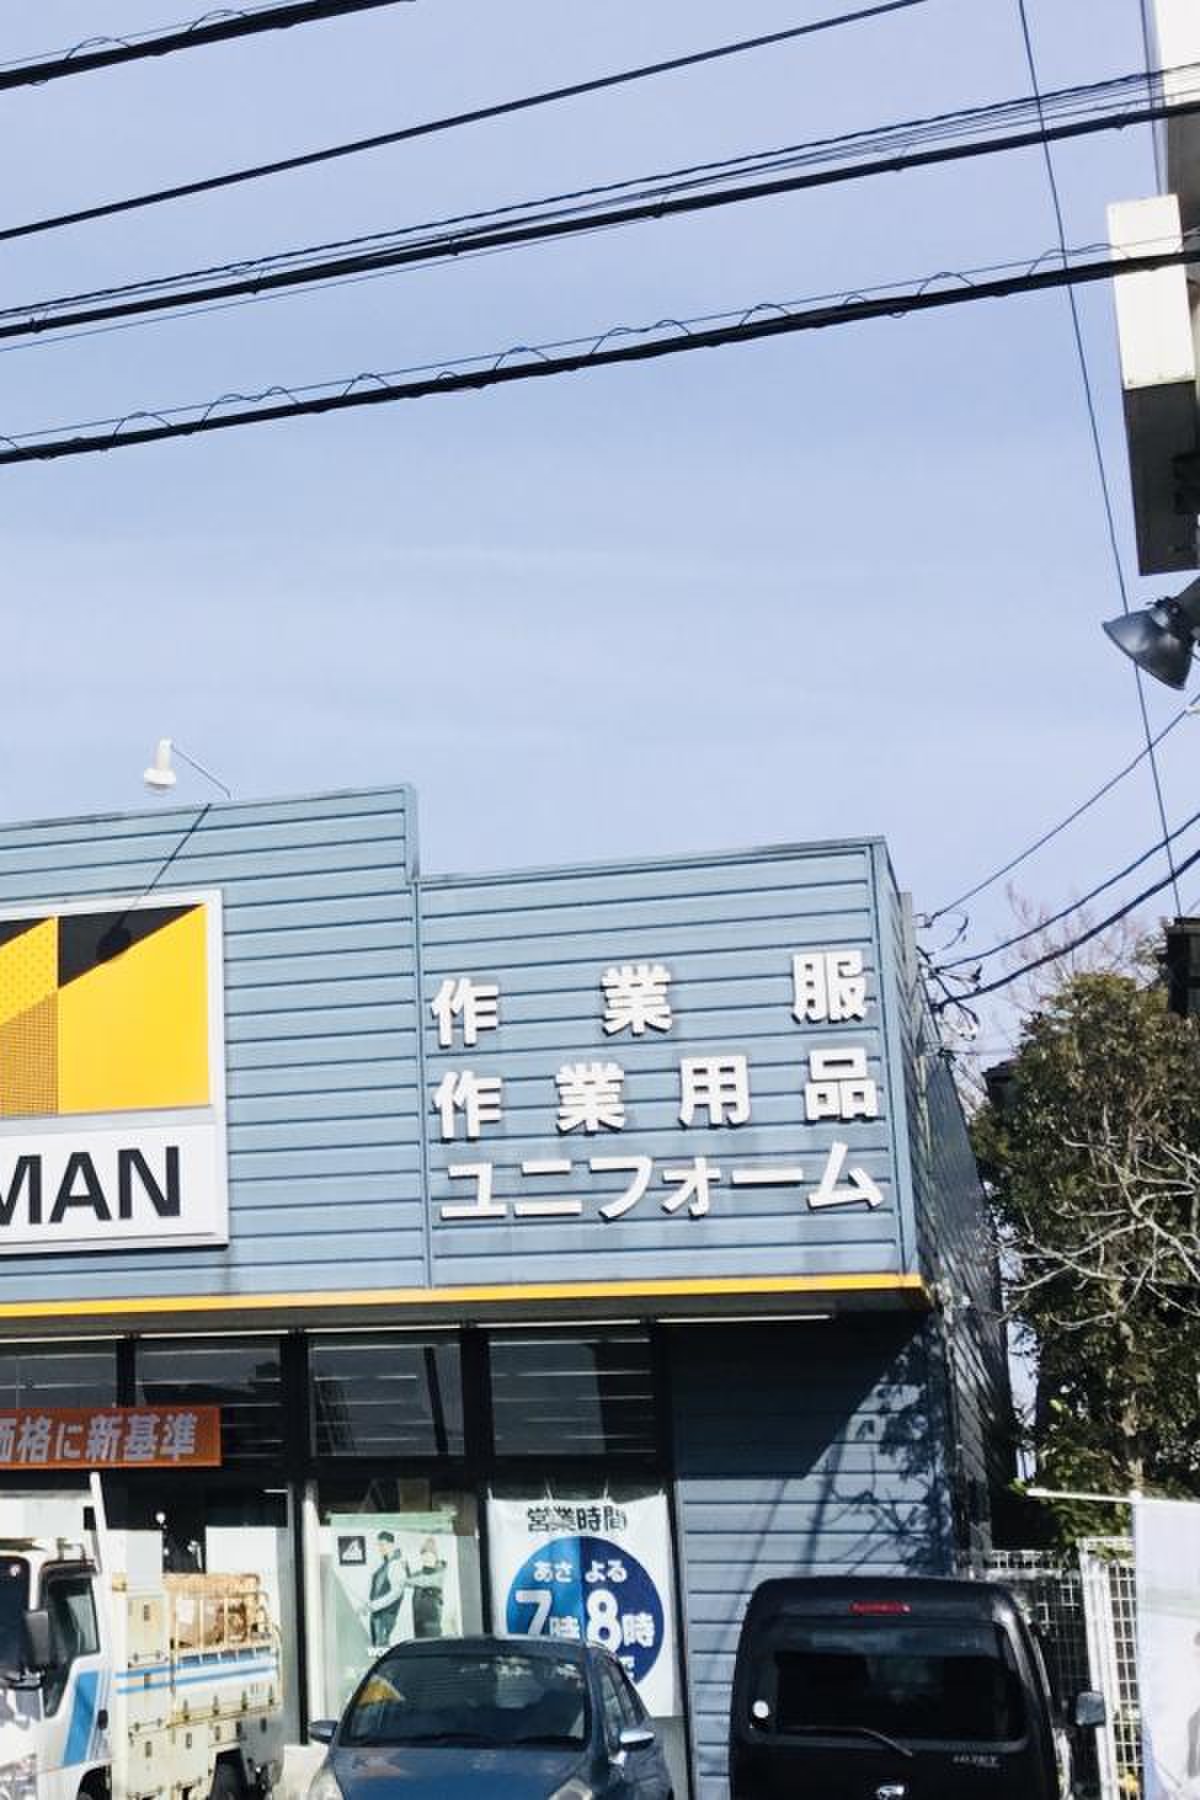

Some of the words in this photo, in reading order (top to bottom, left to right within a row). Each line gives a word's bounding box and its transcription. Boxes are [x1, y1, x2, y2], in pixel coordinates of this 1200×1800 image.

[431, 949, 868, 1048] 作業服
[432, 1047, 878, 1142] 作業用品
[440, 1141, 883, 1220] ユニフォーム
[527, 1505, 627, 1532] 営業時間
[533, 1561, 573, 1583] あさ
[584, 1560, 628, 1583] よる
